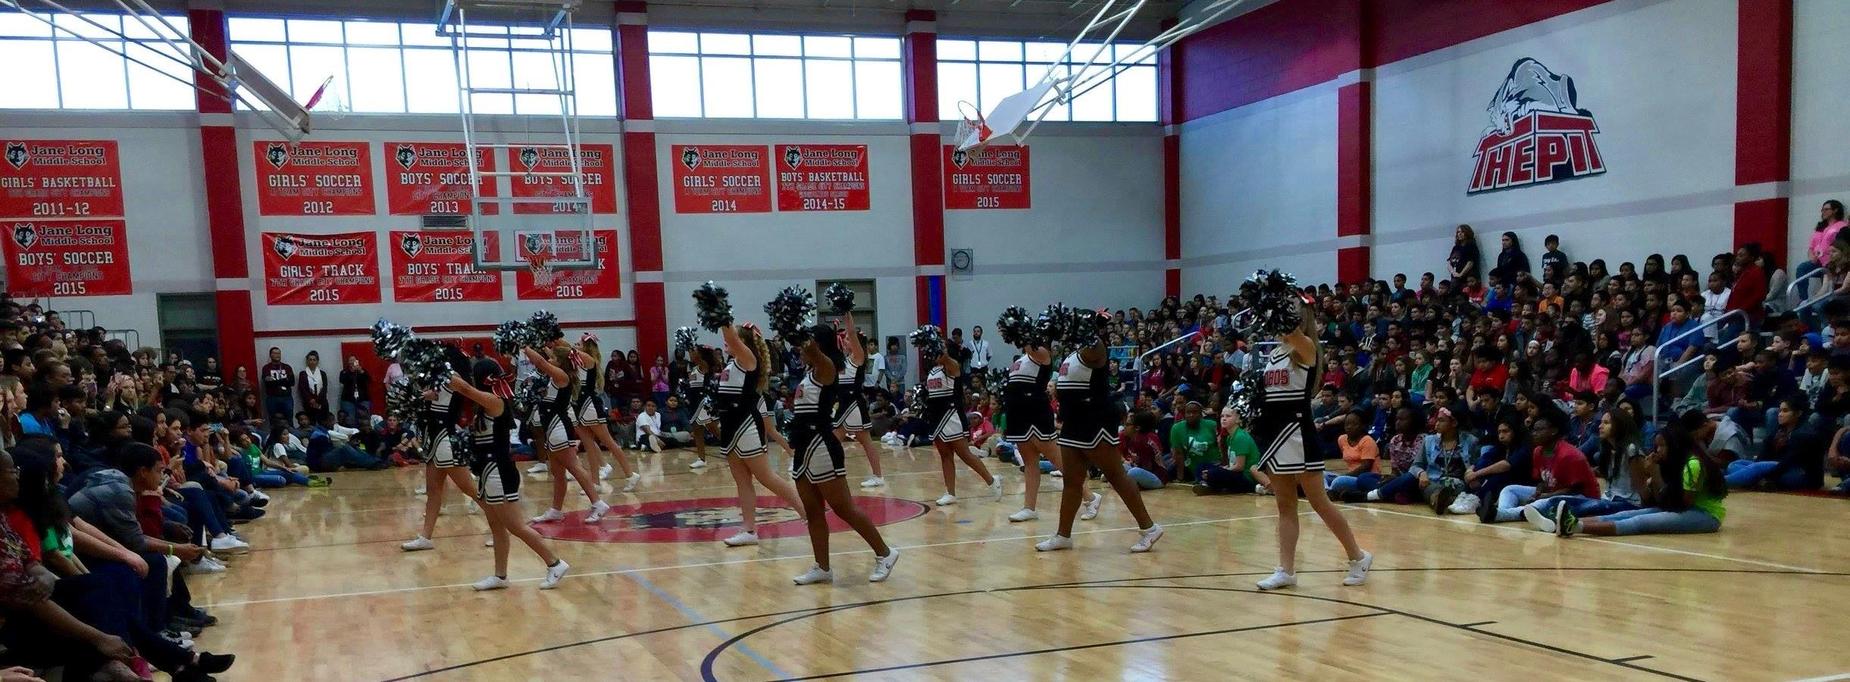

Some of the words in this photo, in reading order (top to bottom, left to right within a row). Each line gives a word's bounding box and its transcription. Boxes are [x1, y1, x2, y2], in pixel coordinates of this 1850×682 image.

[32, 146, 65, 155] Jane
[69, 146, 104, 158] Long
[291, 147, 321, 156] Jane
[325, 147, 357, 158] Long
[419, 148, 448, 157] Jane
[451, 148, 482, 159] Log
[541, 149, 569, 158] Jane
[703, 150, 728, 159] Jane
[731, 150, 759, 160] Long
[803, 149, 829, 159] Jane
[831, 149, 858, 159] Long
[995, 150, 1020, 159] Long
[33, 157, 69, 165] Middle
[71, 157, 106, 165] School
[327, 158, 360, 166] School
[420, 159, 453, 167] Middle
[268, 174, 309, 187] GIRLS'
[315, 175, 362, 187] SOCCER
[400, 173, 434, 184] BOYS'
[561, 173, 602, 185] SOCER
[683, 176, 717, 187] GIRLS'
[723, 176, 761, 187] SOCCER
[781, 173, 805, 181] BOYS'
[809, 172, 864, 181] BASKETBALL
[987, 174, 1021, 184] SOCCER
[1, 177, 37, 188] GIRLS'
[42, 177, 116, 188] BASKETBALL
[303, 201, 334, 214] 2012
[430, 201, 459, 213] 2013
[712, 200, 737, 211] 2014
[803, 199, 845, 209] 2014-15
[977, 197, 999, 207] 2015
[33, 202, 90, 215] 2011-12
[39, 226, 73, 236] Jane
[77, 225, 112, 238] Long
[41, 238, 77, 246] Middle
[79, 237, 114, 245] School
[298, 239, 330, 247] Jane
[331, 238, 365, 248] Long
[424, 236, 453, 245] Jane
[333, 247, 367, 256] School
[425, 247, 458, 255] Middle
[18, 253, 57, 266] BOYS'
[64, 251, 114, 265] SOCCER
[280, 265, 316, 277] GIRLS'
[322, 264, 365, 276] TRACK
[408, 264, 440, 275] BOYS'
[54, 282, 86, 295] 2015
[435, 288, 463, 300] 2015
[556, 286, 583, 297] 2016
[310, 289, 340, 301] 2015
